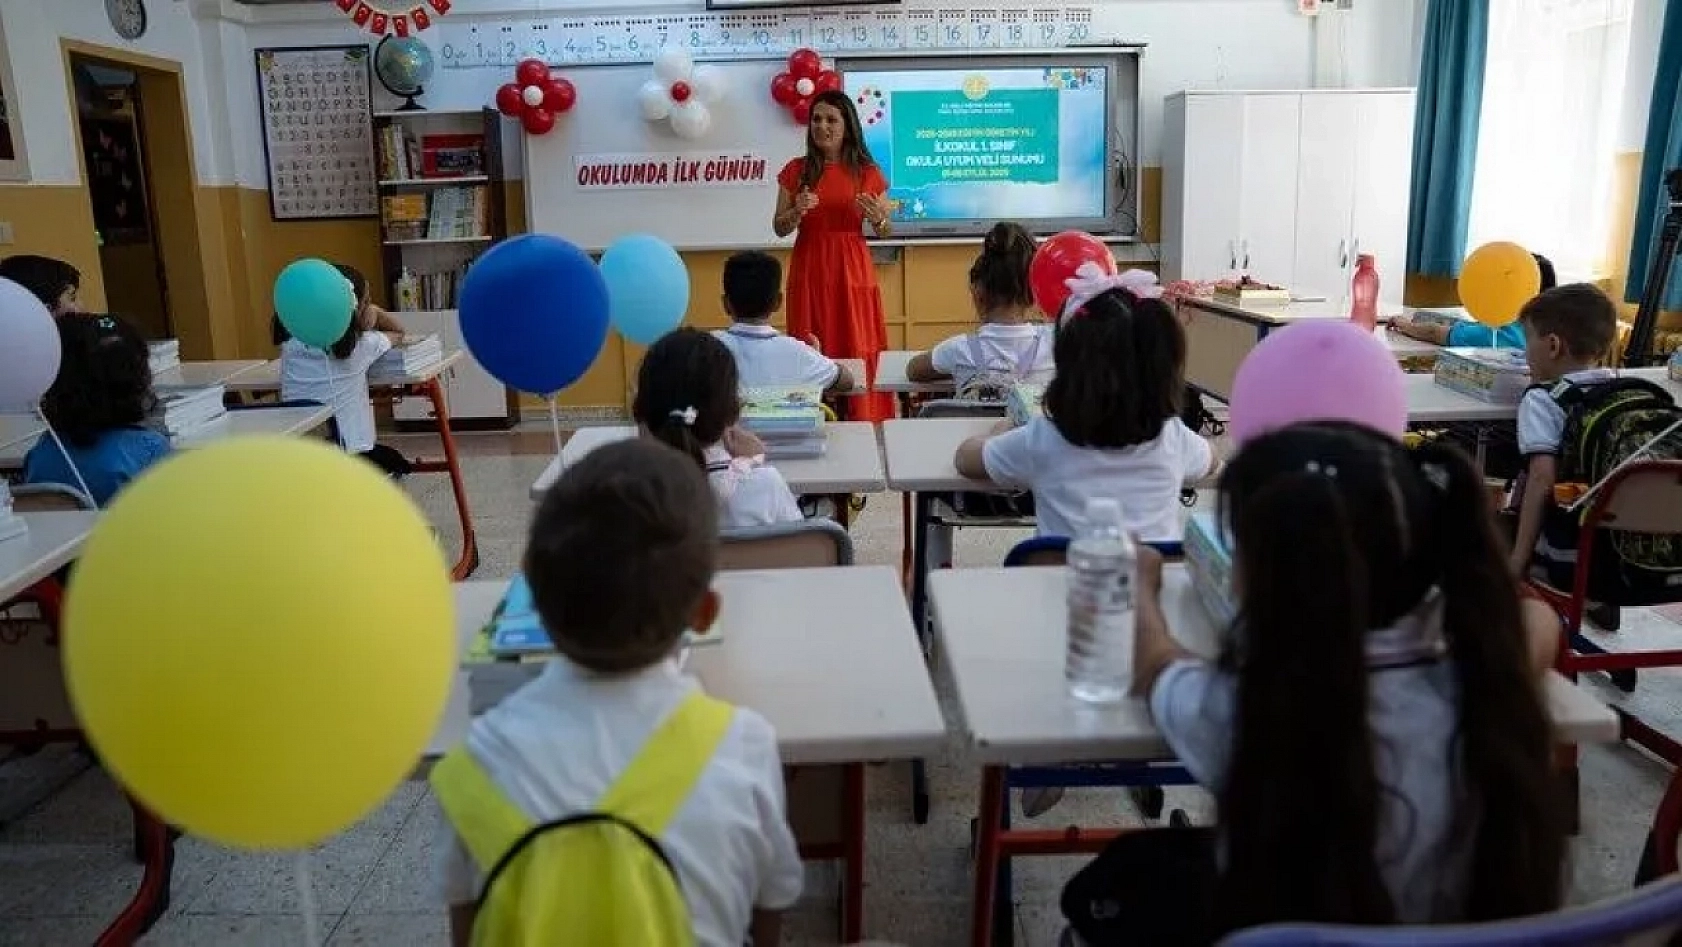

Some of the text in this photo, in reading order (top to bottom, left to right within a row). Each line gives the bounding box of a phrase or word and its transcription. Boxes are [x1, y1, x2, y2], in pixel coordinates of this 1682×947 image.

[443, 43, 453, 59] 0
[506, 41, 515, 58] 2
[535, 39, 545, 55] 3
[564, 38, 576, 53] 4
[596, 36, 606, 51] 5
[628, 34, 639, 50] 6
[658, 32, 667, 47] 7
[690, 31, 700, 47] 8
[721, 30, 730, 45] 9
[752, 29, 769, 45] 10
[789, 28, 802, 44] 11
[820, 27, 835, 43] 12
[852, 26, 867, 42] 13
[881, 25, 898, 42] 14
[914, 25, 929, 41] 15
[944, 25, 961, 40] 16
[977, 25, 990, 40] 17
[1007, 24, 1022, 40] 18
[1039, 24, 1056, 40] 19
[1068, 23, 1089, 39] 20
[577, 155, 766, 186] OKULUMDA İLK GÜNÜM
[905, 155, 942, 167] OKULA
